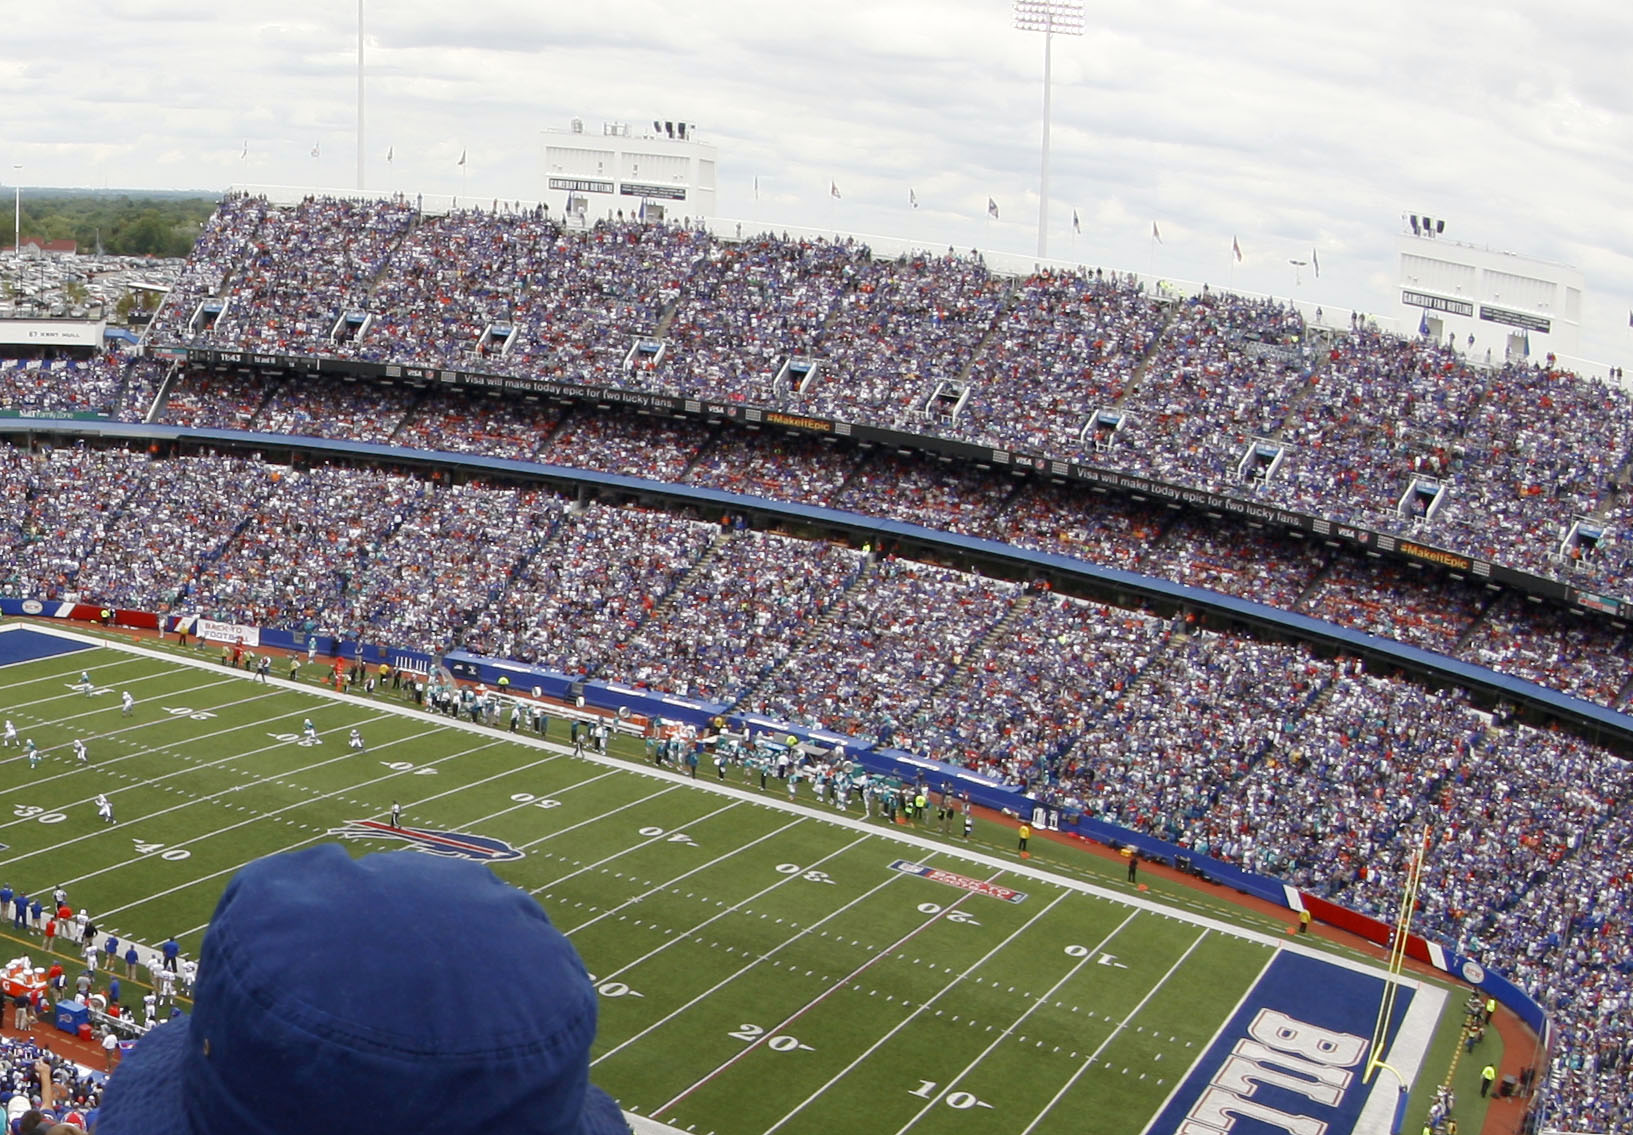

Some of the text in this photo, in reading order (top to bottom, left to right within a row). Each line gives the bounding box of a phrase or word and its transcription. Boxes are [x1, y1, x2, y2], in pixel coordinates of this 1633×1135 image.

[220, 353, 241, 362] 11:43
[407, 368, 423, 377] VISA
[464, 373, 484, 385] Visa
[486, 377, 502, 386] will
[505, 379, 531, 391] make
[533, 382, 561, 395] today
[562, 386, 584, 397] epic
[586, 388, 600, 398] for
[603, 389, 620, 401] two
[622, 393, 649, 406] lucky
[708, 404, 725, 414] VISA
[766, 412, 832, 432] #MakeItEpic
[1077, 467, 1303, 527] Visa will make today epic for two lucky fans.
[1337, 527, 1356, 539] VISA
[1399, 543, 1469, 571] #MakeItEpic
[231, 626, 242, 634] TO
[14, 805, 67, 824] 30
[133, 840, 191, 861] 40
[775, 863, 829, 883] 30
[917, 903, 970, 923] 20
[1064, 945, 1117, 966] 10
[728, 1024, 800, 1052] 20
[909, 1080, 981, 1109] 10
